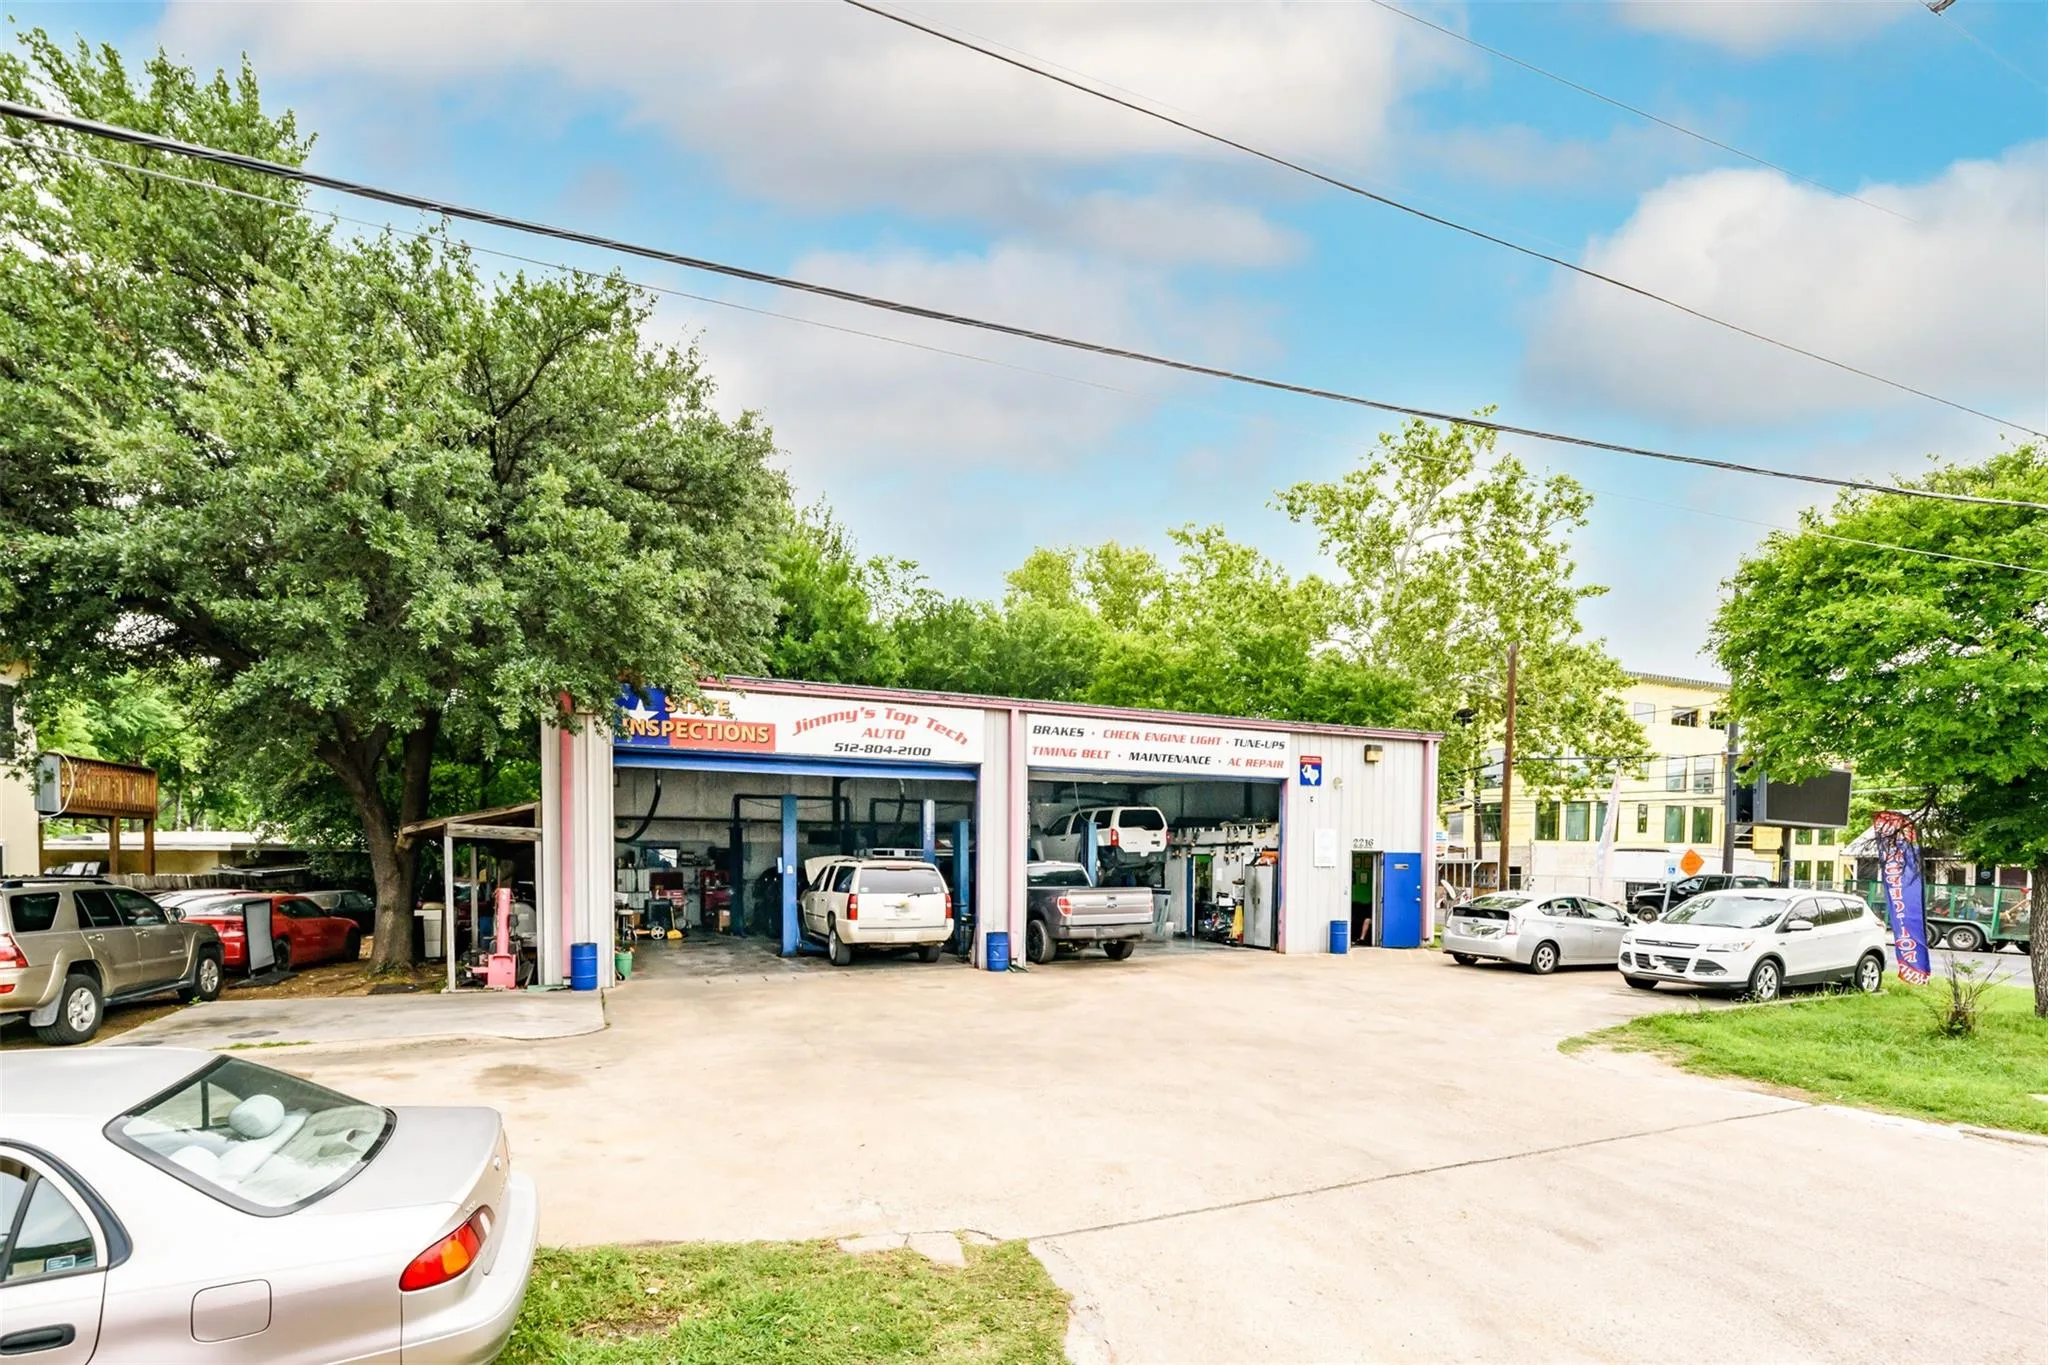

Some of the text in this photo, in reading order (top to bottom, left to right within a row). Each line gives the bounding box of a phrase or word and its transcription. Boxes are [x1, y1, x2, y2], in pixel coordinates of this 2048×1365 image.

[622, 718, 770, 743] INSPECTIONS
[792, 707, 968, 746] Jimmy's Top Tech
[861, 727, 906, 740] AUTO
[1032, 725, 1286, 750] BRAKES CHECK ENGINE LIGHT TUNE-UPS
[834, 742, 932, 757] 512-804-2100
[1032, 746, 1285, 769] TIMING BELT MAINTENANCE AC REPAIR
